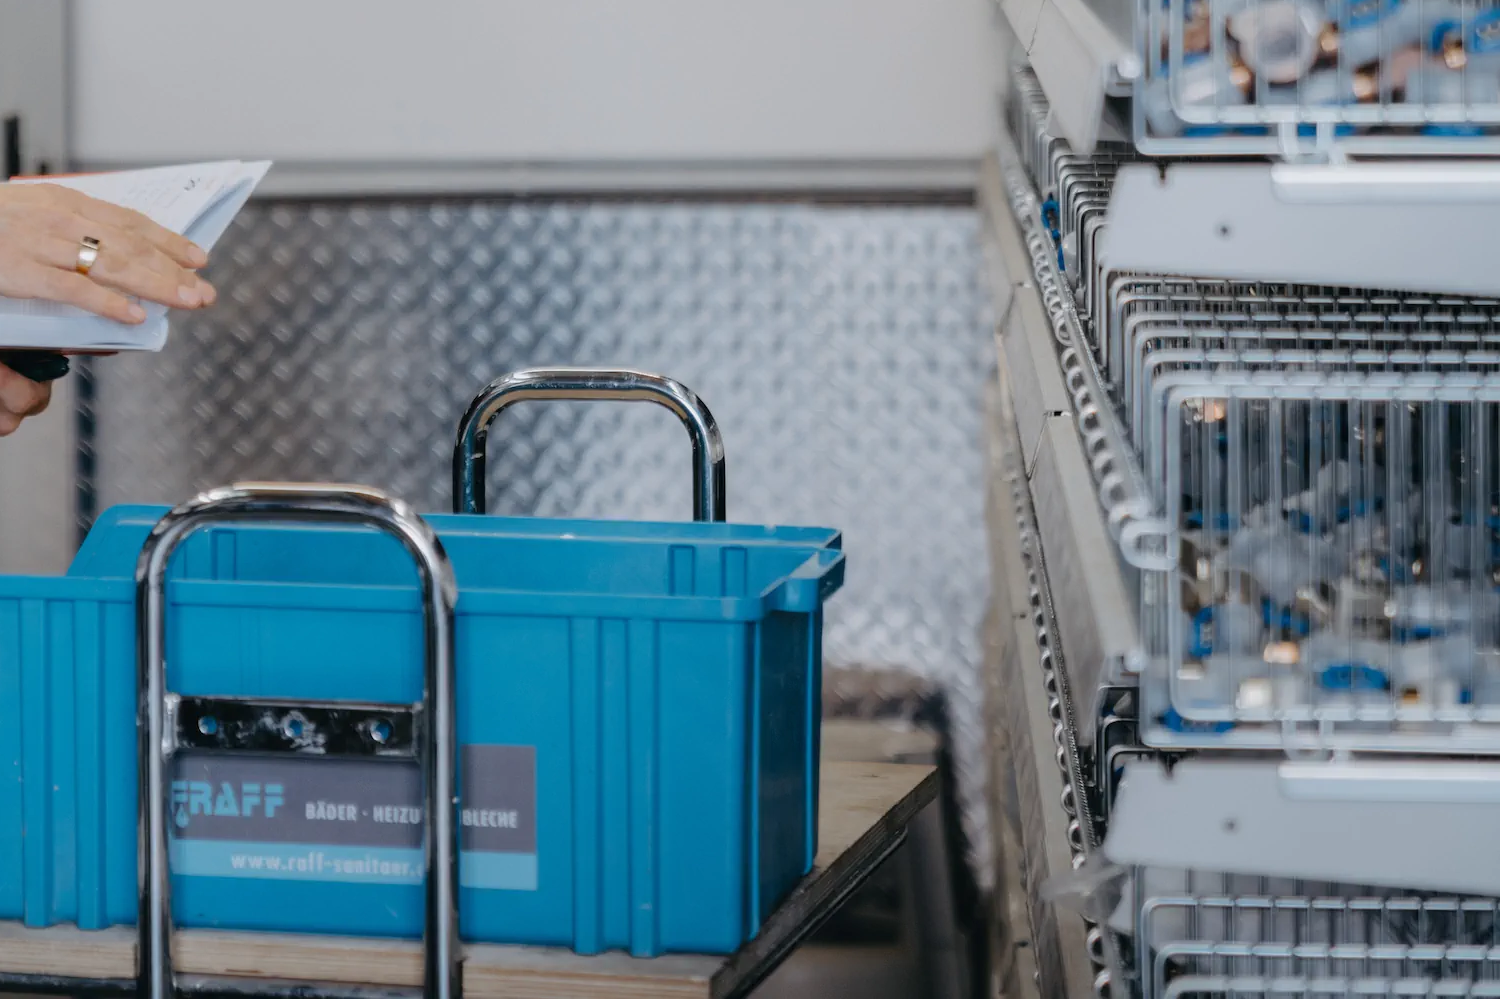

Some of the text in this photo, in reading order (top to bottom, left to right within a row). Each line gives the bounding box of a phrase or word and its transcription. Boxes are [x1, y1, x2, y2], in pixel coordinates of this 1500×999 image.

[305, 801, 357, 822] BÄDER
[373, 805, 422, 825] HEIZU
[231, 852, 423, 878] www.raff-sanitaer.
